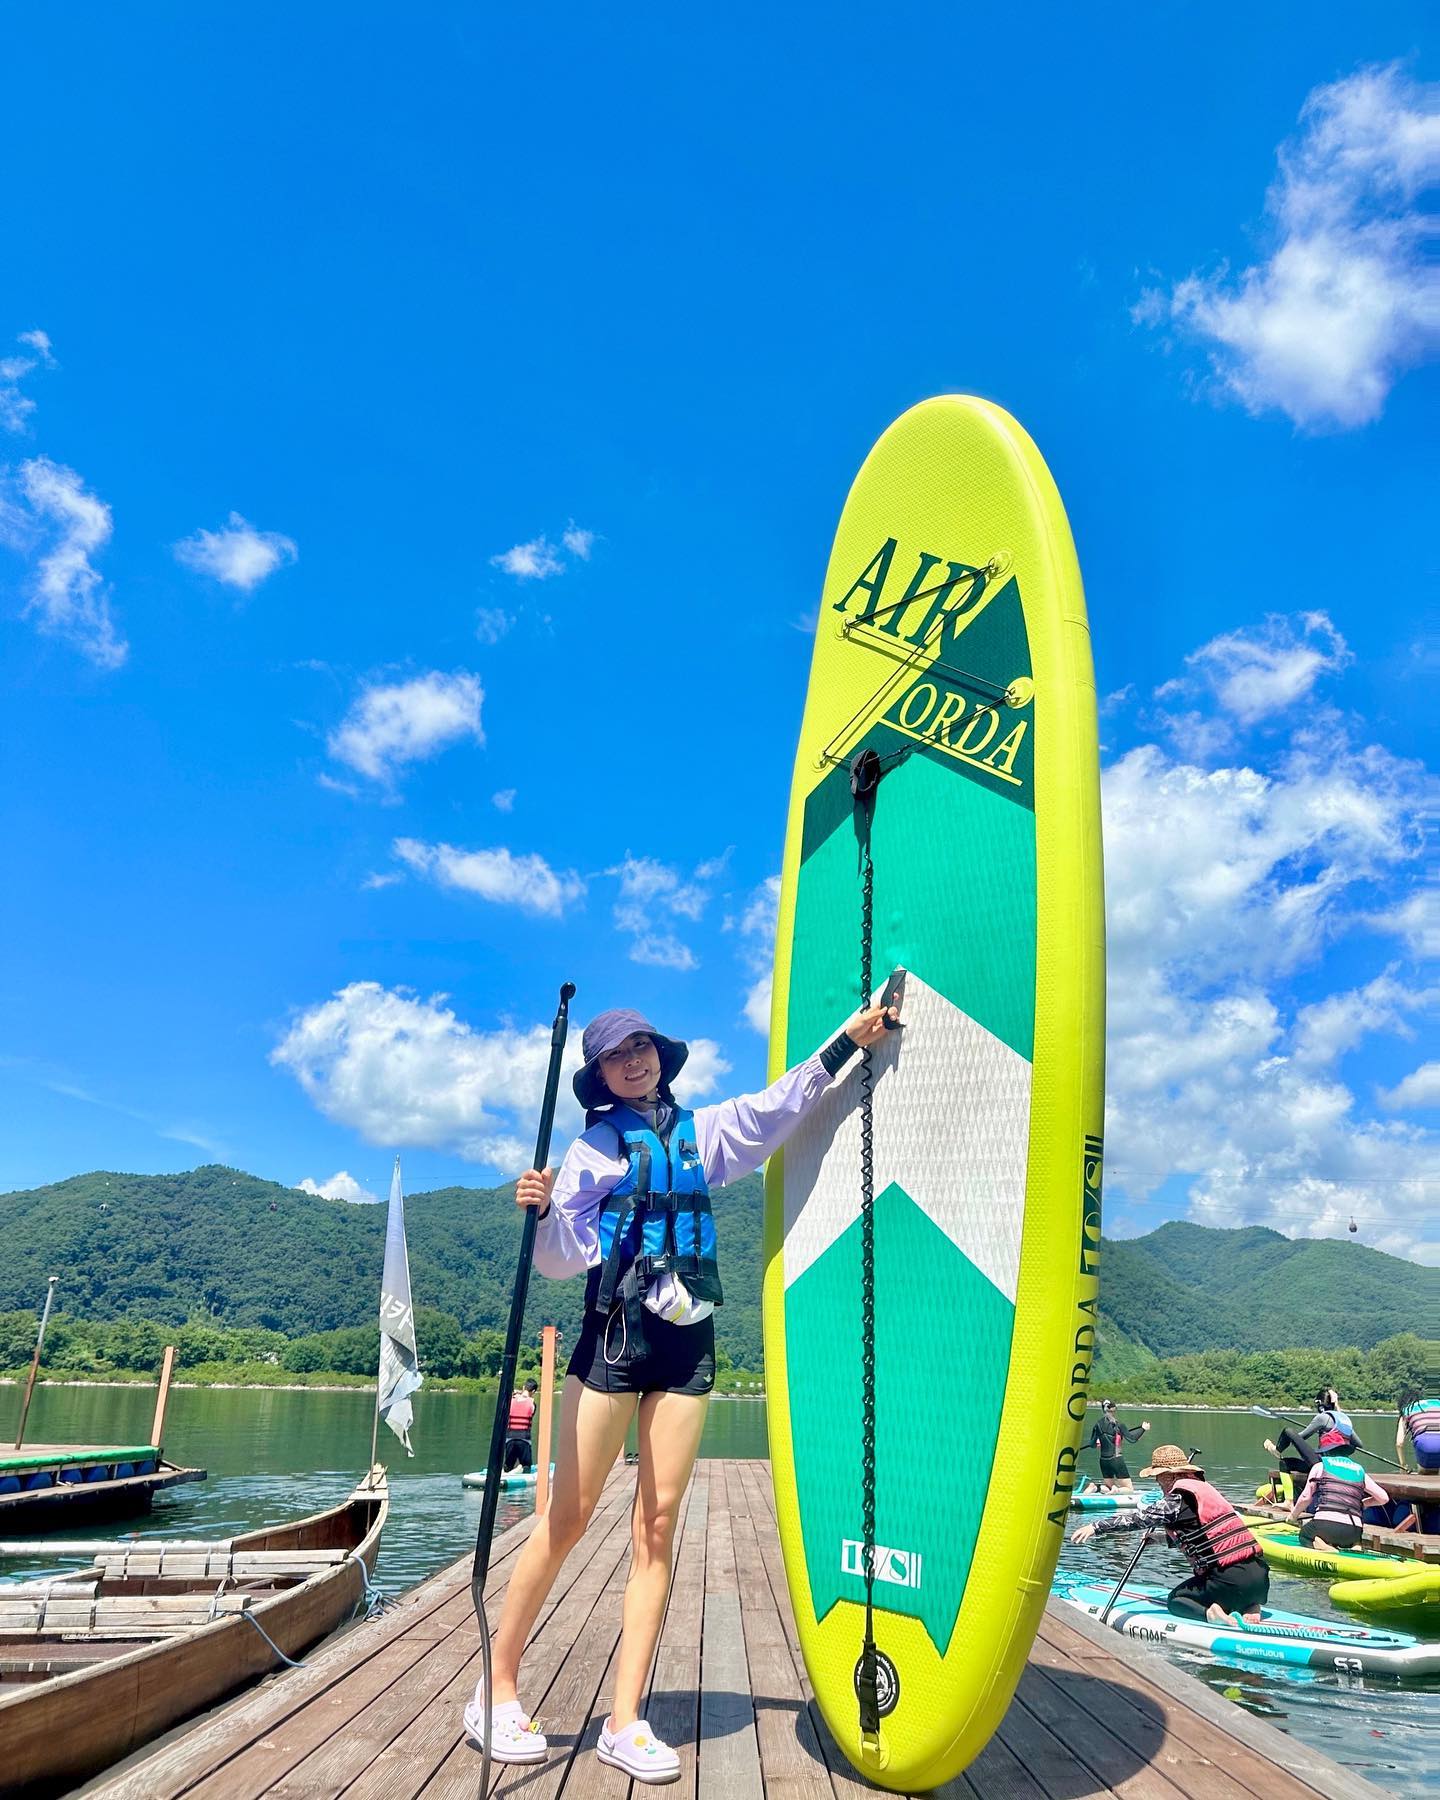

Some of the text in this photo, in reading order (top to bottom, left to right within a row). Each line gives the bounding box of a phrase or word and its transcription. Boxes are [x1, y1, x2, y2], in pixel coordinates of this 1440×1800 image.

[832, 537, 987, 652] AIR
[899, 683, 1028, 774] ORDA
[1047, 1446, 1079, 1528] AIR
[1067, 1299, 1097, 1422] ORDA
